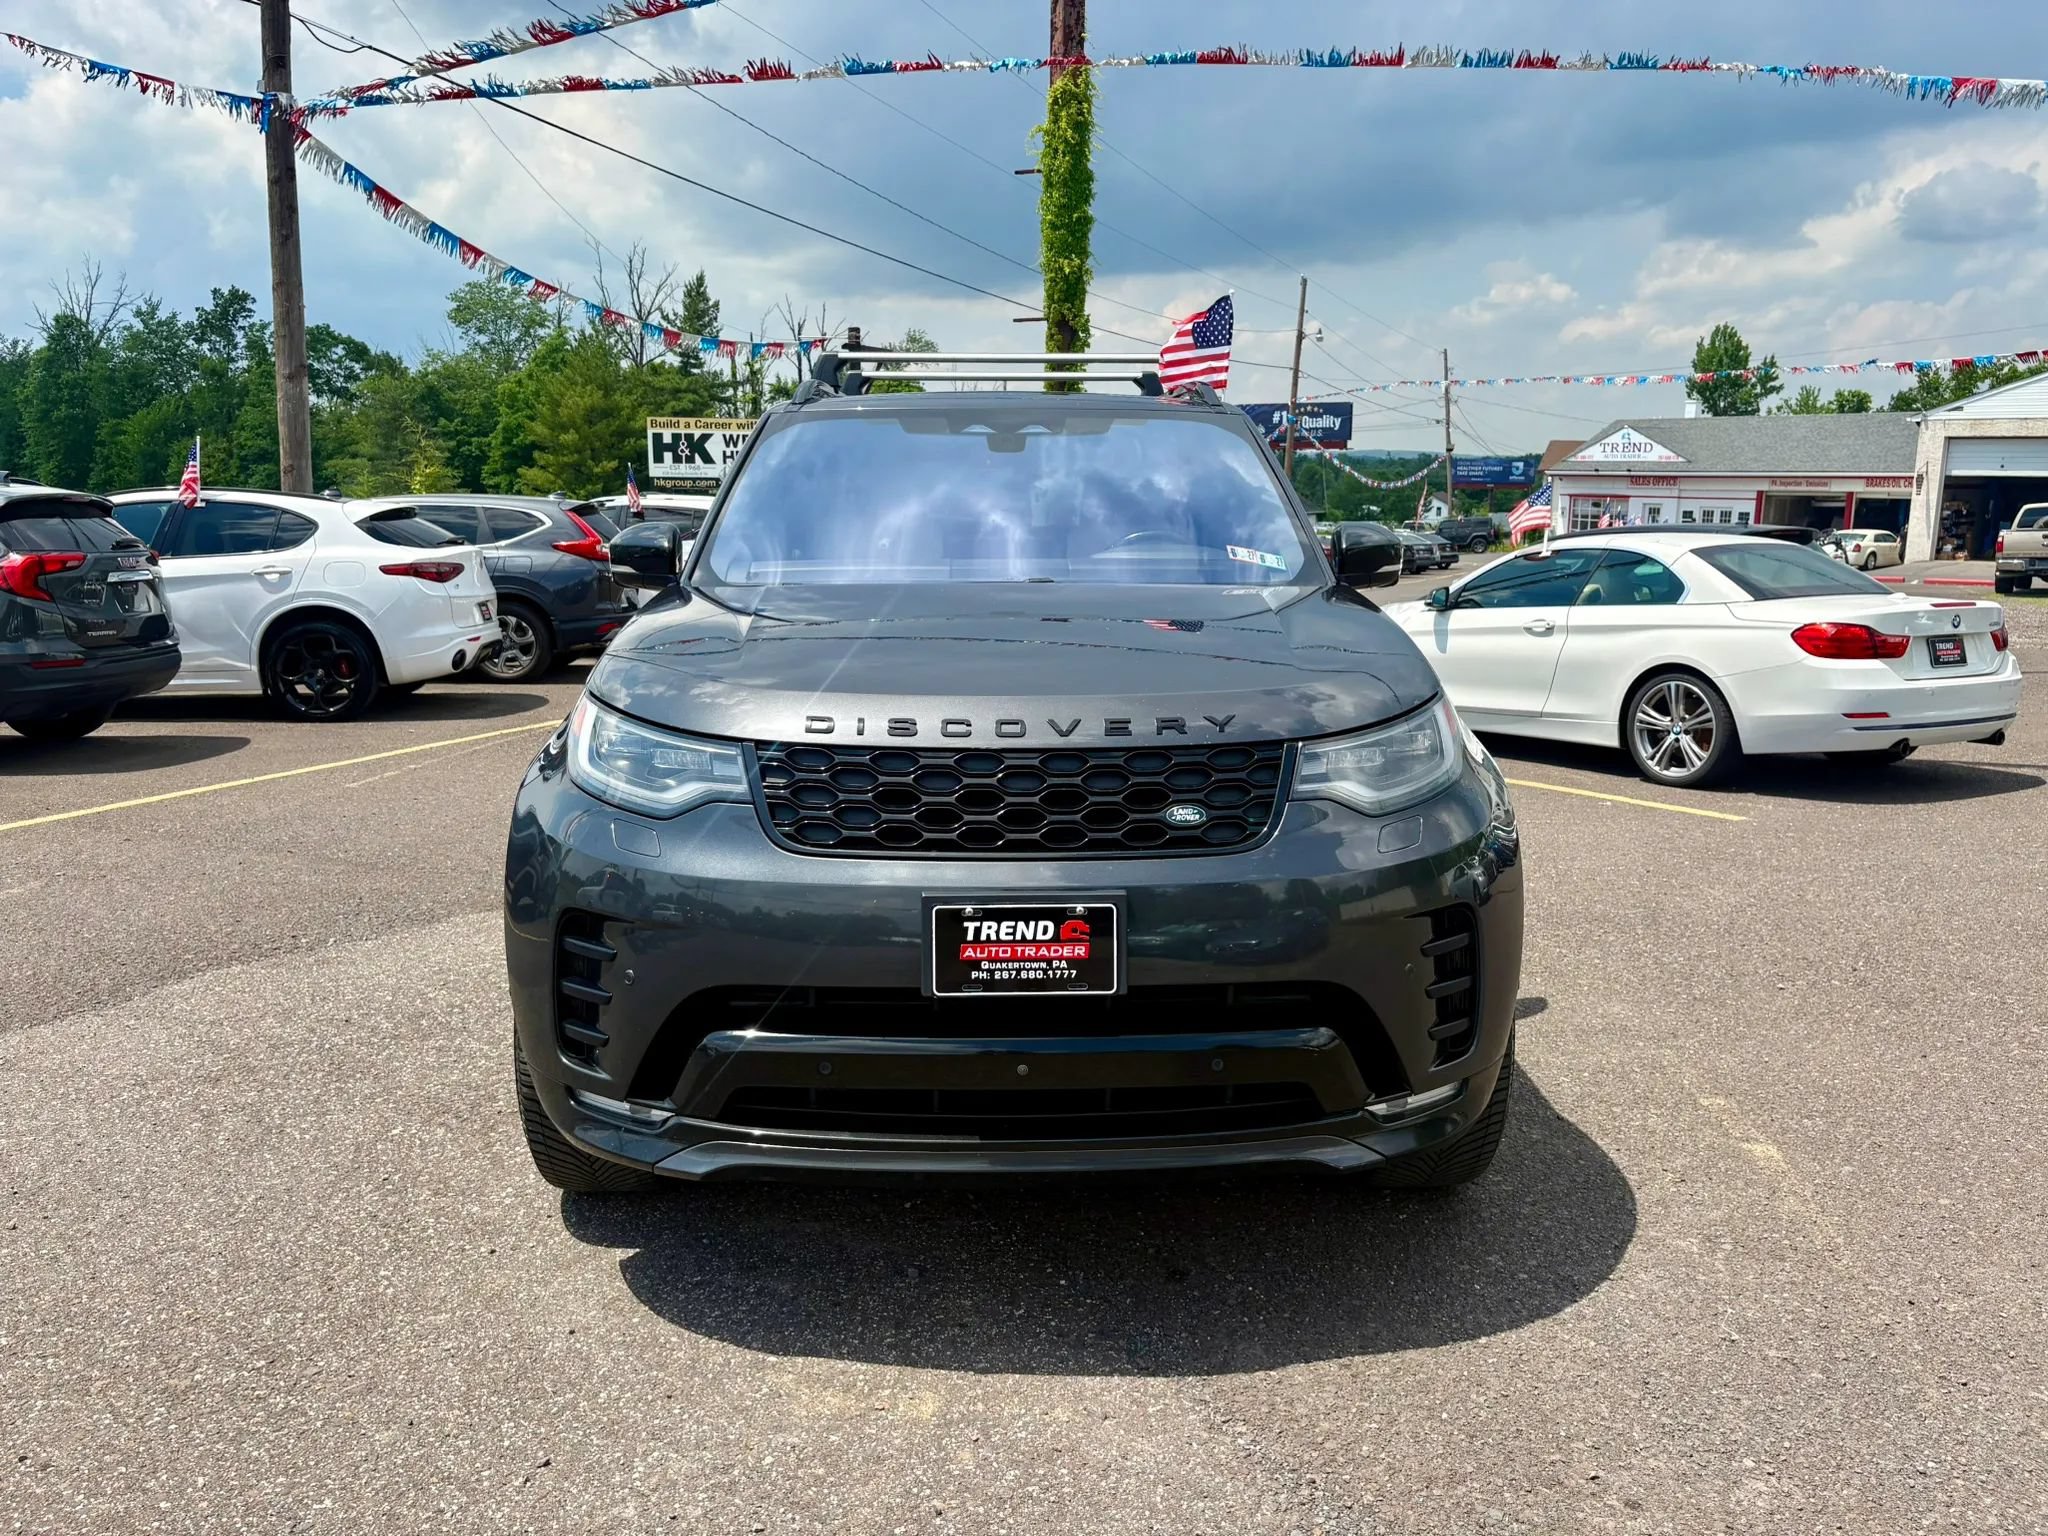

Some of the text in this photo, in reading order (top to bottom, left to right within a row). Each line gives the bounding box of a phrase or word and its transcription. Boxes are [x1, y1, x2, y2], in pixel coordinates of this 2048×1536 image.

[650, 418, 680, 429] Build
[684, 421, 691, 429] a
[694, 420, 732, 430] Career
[1301, 414, 1342, 431] Quality
[652, 432, 716, 464] H&K
[1599, 442, 1653, 453] TREND
[654, 478, 716, 488] hkgroup.com
[1630, 476, 1677, 487] SALES OFFICE
[1865, 477, 1890, 488] BRAKES
[1936, 642, 1954, 650] TREND
[804, 713, 1237, 738] DISCOVERY
[963, 920, 1055, 942] TREND
[1052, 960, 1068, 968] PA
[971, 970, 1077, 980] PH: 267.680.1777
